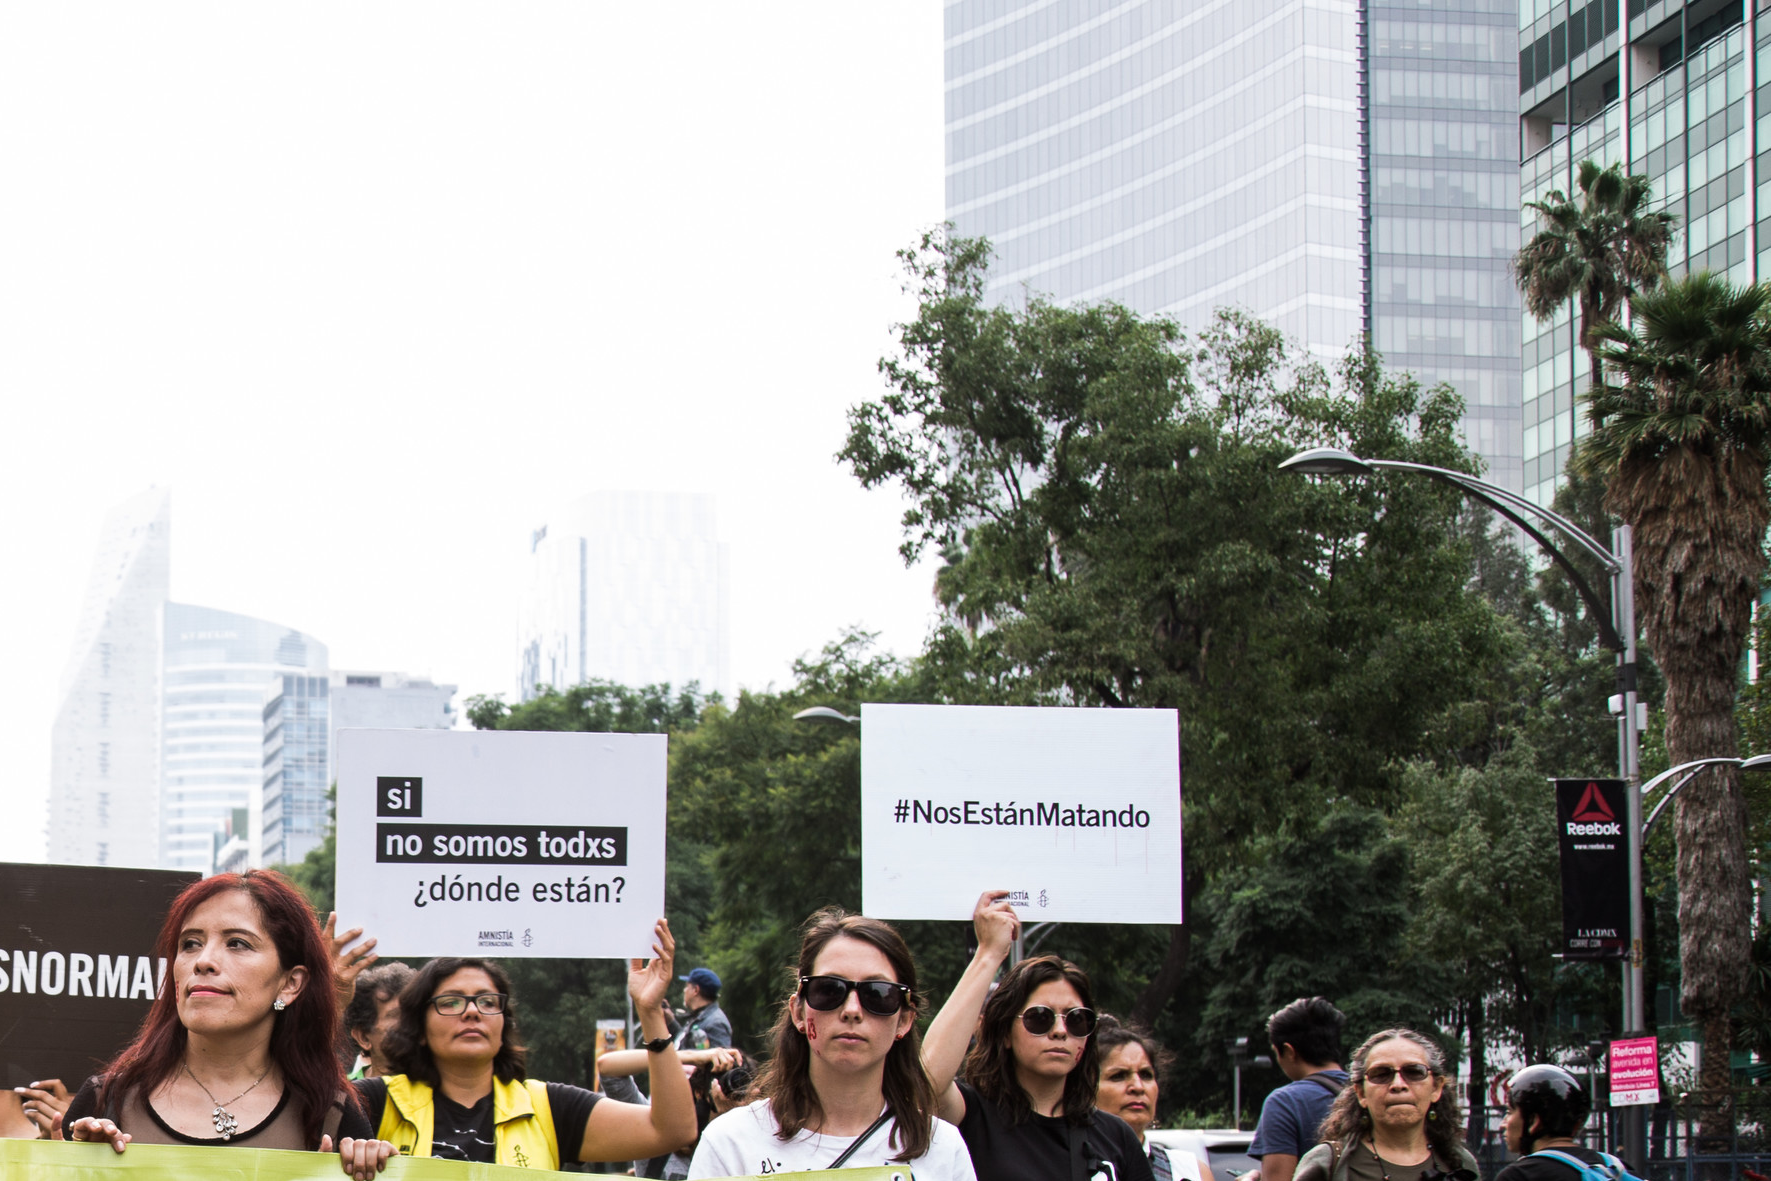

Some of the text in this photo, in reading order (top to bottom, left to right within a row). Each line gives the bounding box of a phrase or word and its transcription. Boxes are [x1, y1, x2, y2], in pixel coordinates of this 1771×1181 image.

[386, 780, 412, 811] si
[893, 799, 1151, 828] #NosEstánMatando
[1566, 822, 1621, 835] Reebok
[385, 831, 617, 859] no somos todxs
[414, 875, 626, 908] ¿dónde están?
[478, 930, 514, 940] AMNISTÍA
[1612, 1046, 1652, 1057] Reforma
[1612, 1057, 1653, 1068] avenida en
[1612, 1067, 1654, 1079] evolución
